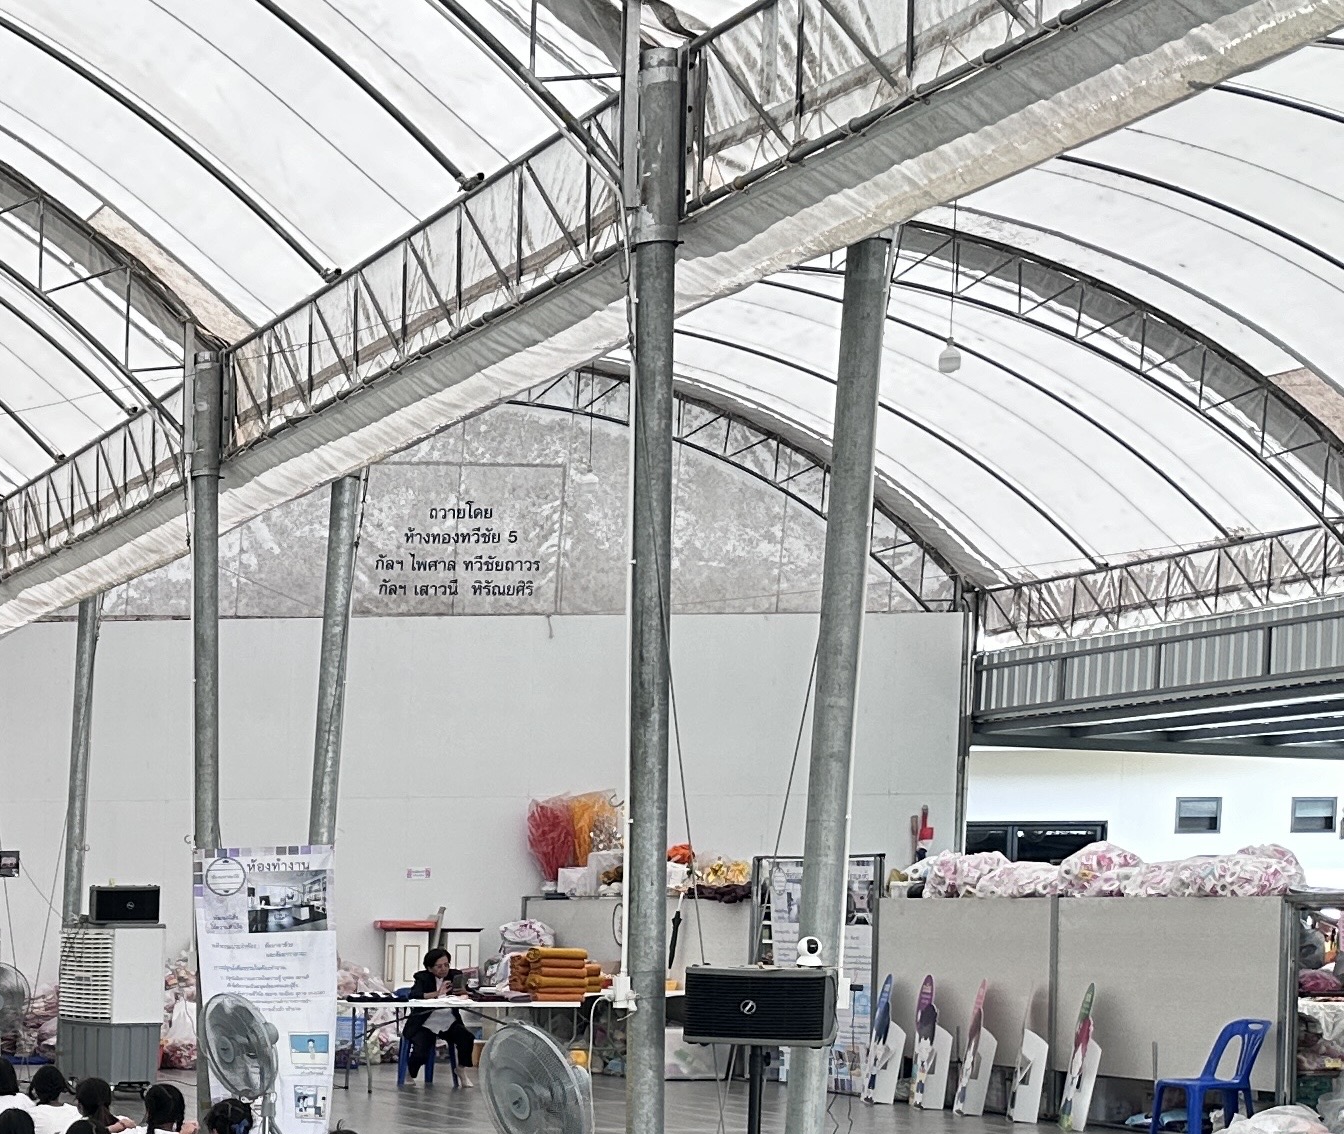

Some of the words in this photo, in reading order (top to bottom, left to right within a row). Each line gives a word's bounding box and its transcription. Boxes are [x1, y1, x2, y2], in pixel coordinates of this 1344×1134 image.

[429, 501, 493, 520] ถวายโดย
[404, 527, 501, 545] ห้างทองทวีชัย
[508, 530, 518, 544] 5
[375, 554, 404, 571] กัลฯ
[409, 553, 456, 572] ไพศาล
[462, 555, 540, 572] ทวีชัยถาวร
[378, 579, 407, 597] กัลฯ
[247, 858, 310, 873] ห้องทำงาน
